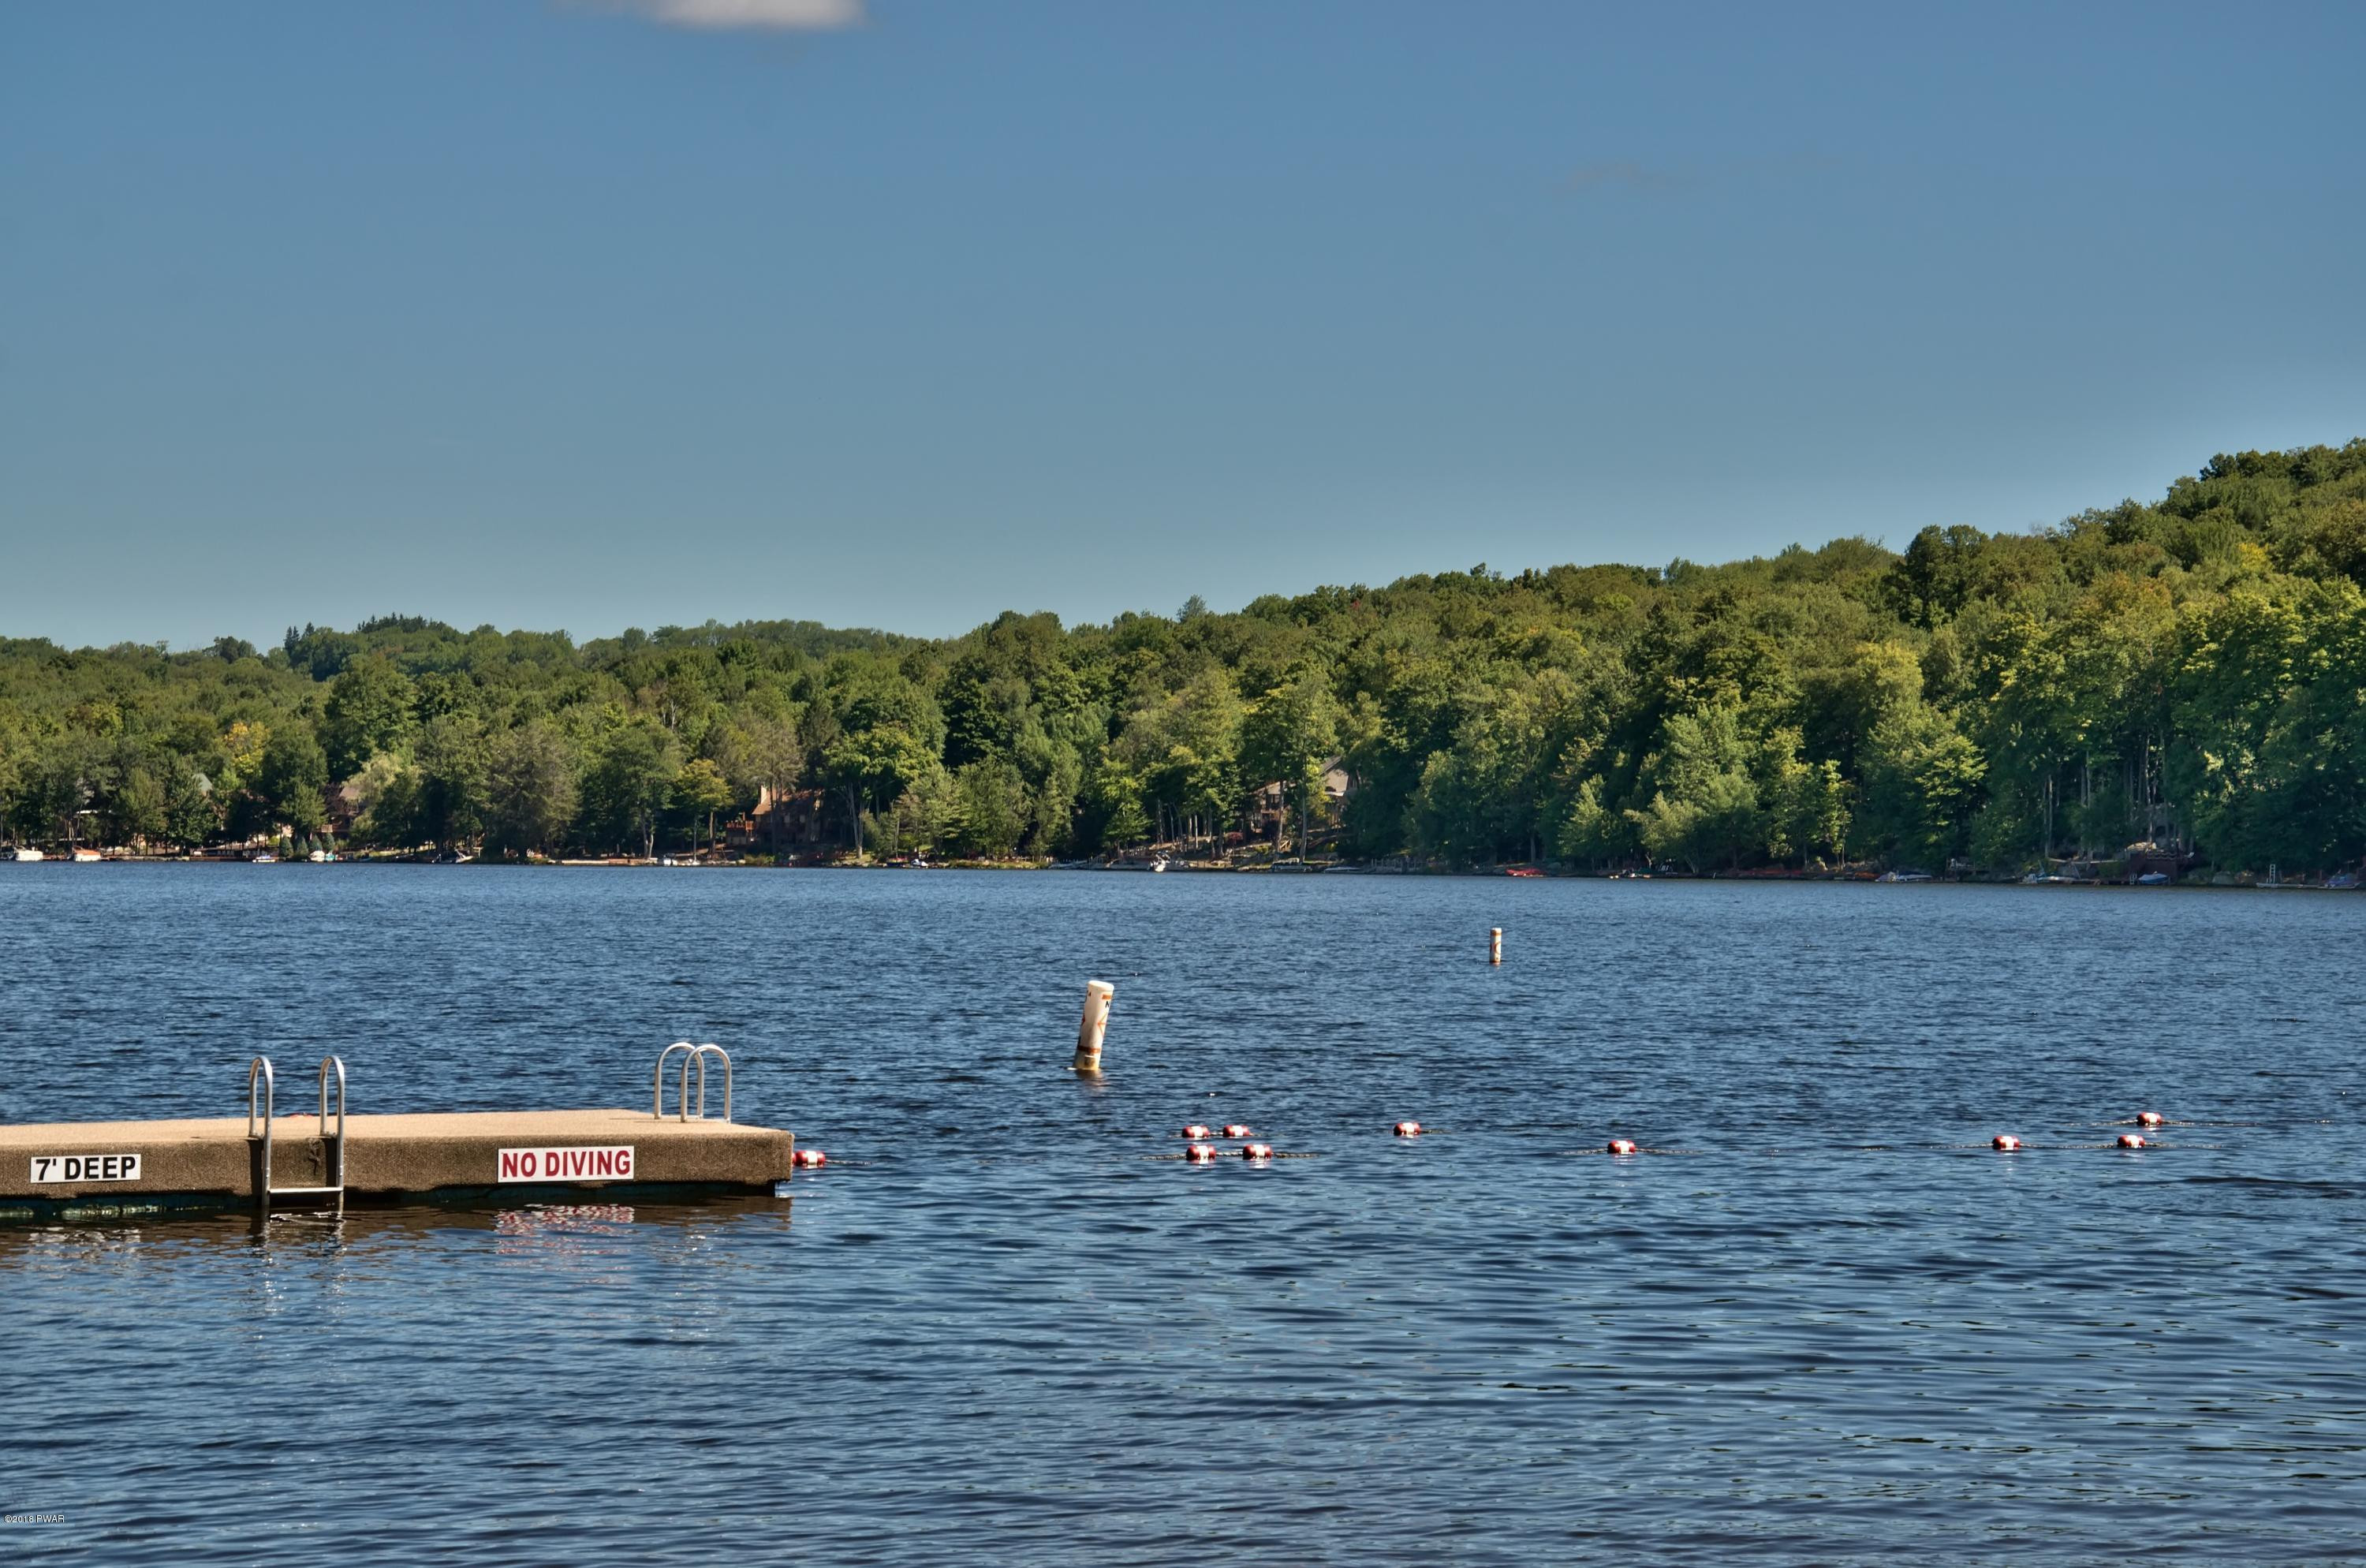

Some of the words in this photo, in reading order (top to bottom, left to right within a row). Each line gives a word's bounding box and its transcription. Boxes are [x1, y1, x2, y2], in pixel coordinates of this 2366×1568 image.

[35, 1159, 57, 1181] 7'
[65, 1156, 136, 1180] DEEP
[502, 1152, 536, 1178] NO
[545, 1150, 630, 1176] DIVING
